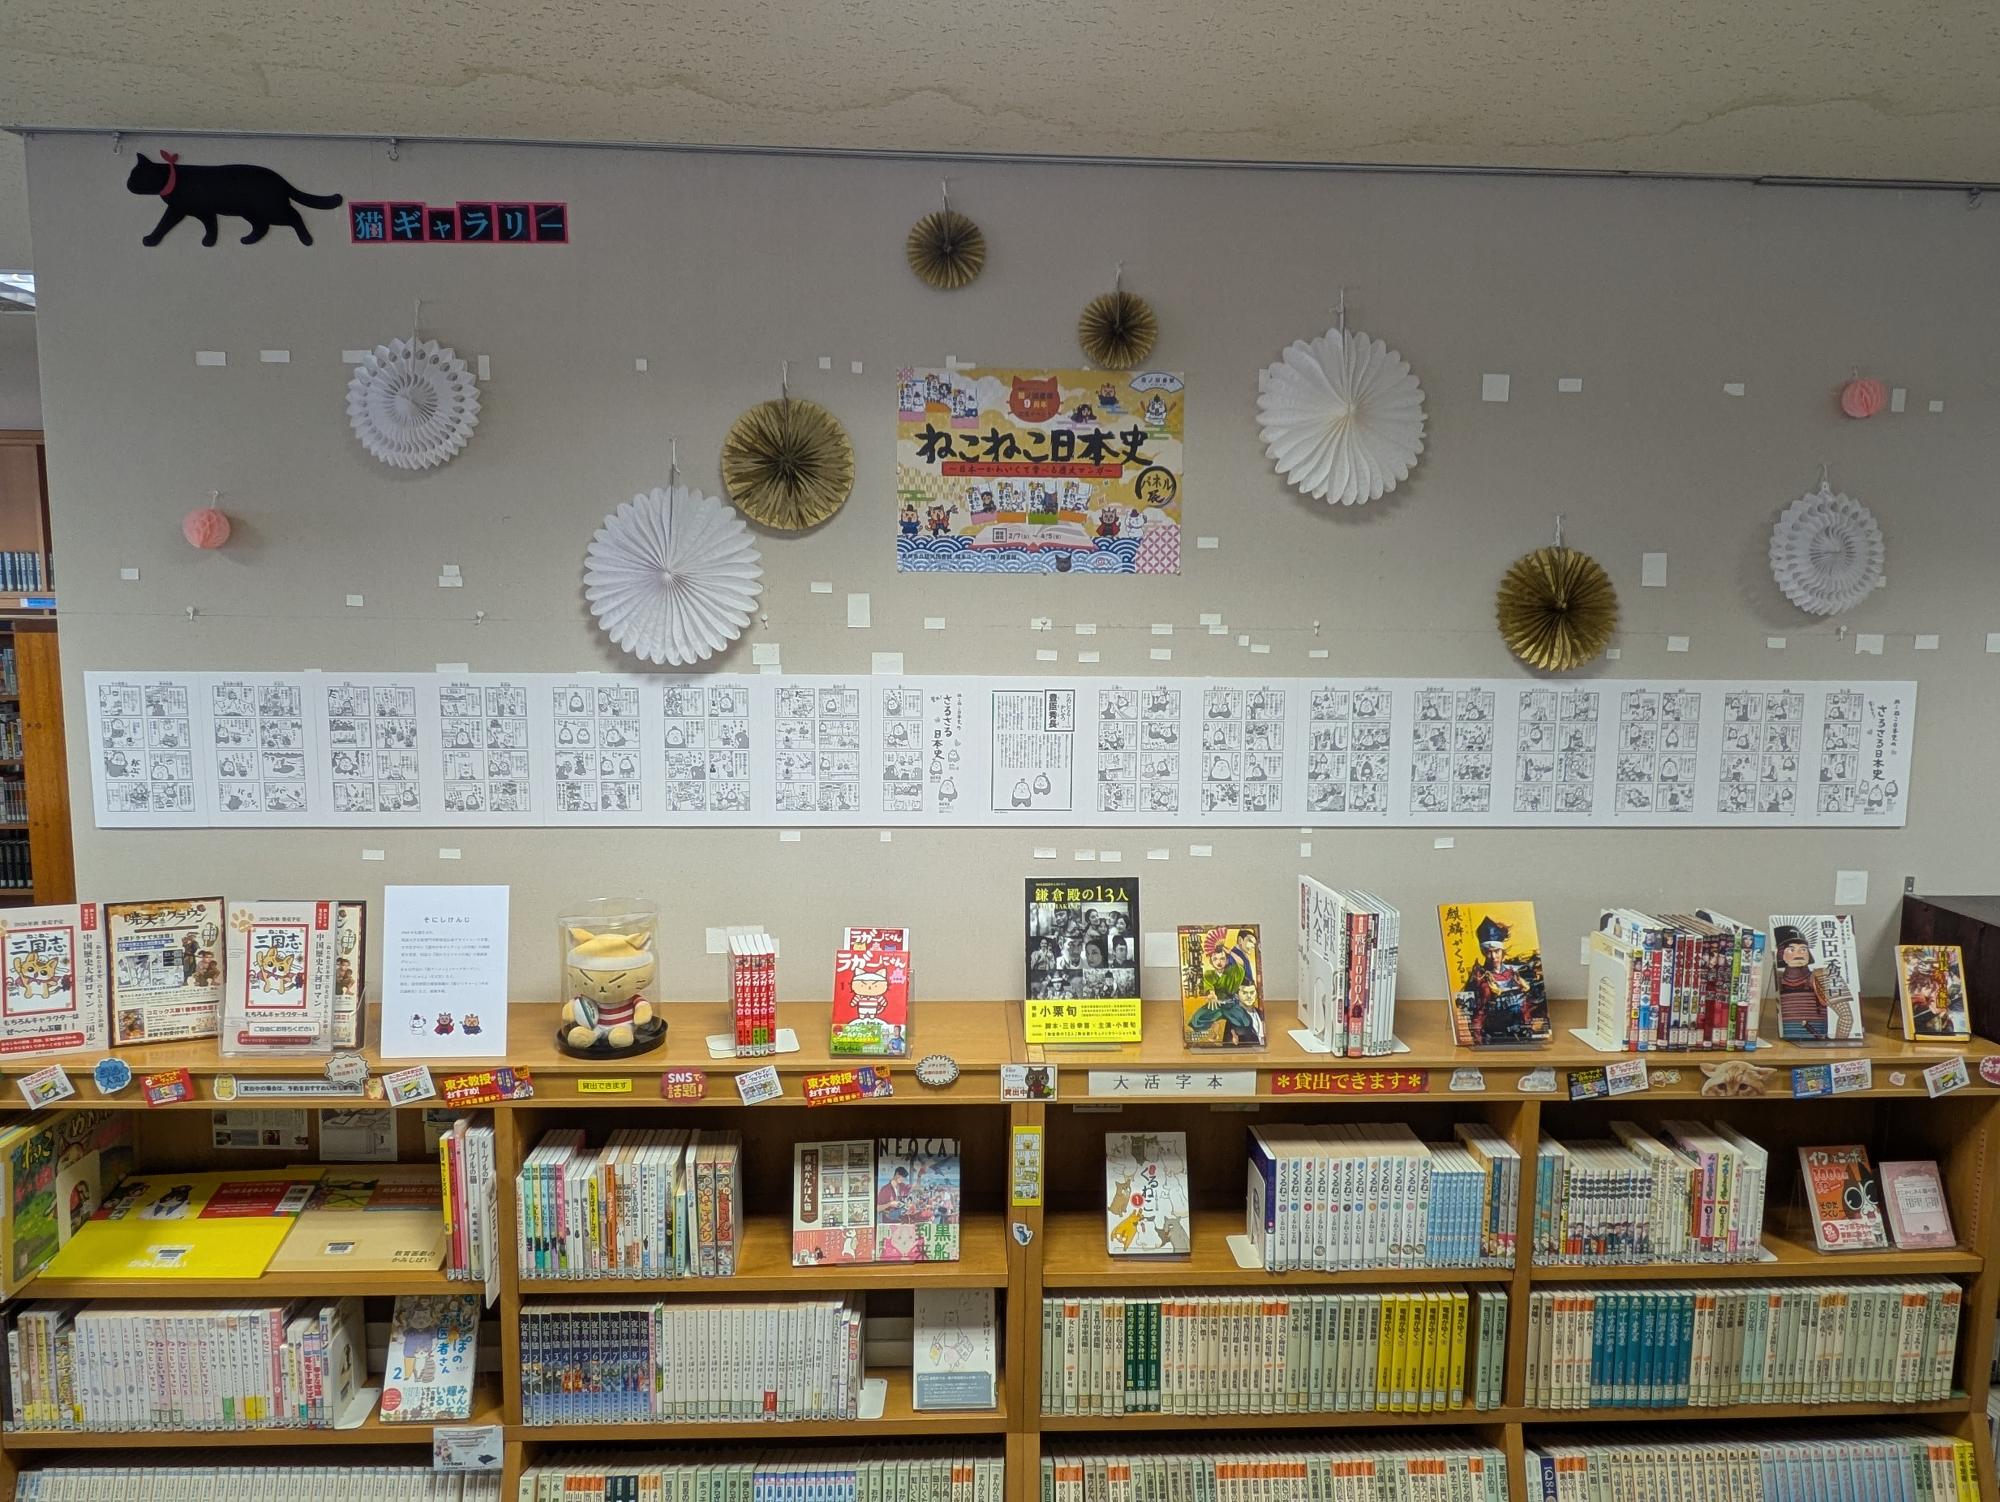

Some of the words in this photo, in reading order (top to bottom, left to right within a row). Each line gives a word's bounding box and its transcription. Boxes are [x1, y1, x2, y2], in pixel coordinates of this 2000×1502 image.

[354, 211, 564, 241] 猫ギャラリー
[915, 423, 1153, 467] ねこねこ日本史
[1141, 475, 1172, 491] パネル
[943, 695, 952, 737] さるさる
[931, 730, 945, 760] 日本史
[1035, 885, 1128, 902] 鎌倉殿の13人
[10, 936, 67, 956] 三国志
[254, 933, 302, 950] 三国志
[850, 929, 903, 944] ラガーにゃん
[1446, 906, 1465, 974] 麒麟がくる
[83, 933, 94, 1008] 中国歴史大河ロマン
[314, 933, 324, 1007] 中国歴史大河ロマン
[837, 952, 906, 972] ラガーにゃん
[1353, 933, 1367, 1005] 戦国1000人
[1040, 1005, 1077, 1017] 小栗旬
[582, 1081, 628, 1090] 貸出できます
[667, 1072, 704, 1083] SNSで
[1113, 1074, 1223, 1090] 大活字本
[1294, 1072, 1406, 1090] 貸出できます
[667, 1084, 704, 1099] 話題!
[1004, 1087, 1028, 1097] 貸出中
[1140, 1166, 1158, 1212] くるねこ
[915, 1224, 931, 1260] 到来
[934, 1224, 950, 1260] 黒船
[393, 1366, 402, 1380] 2
